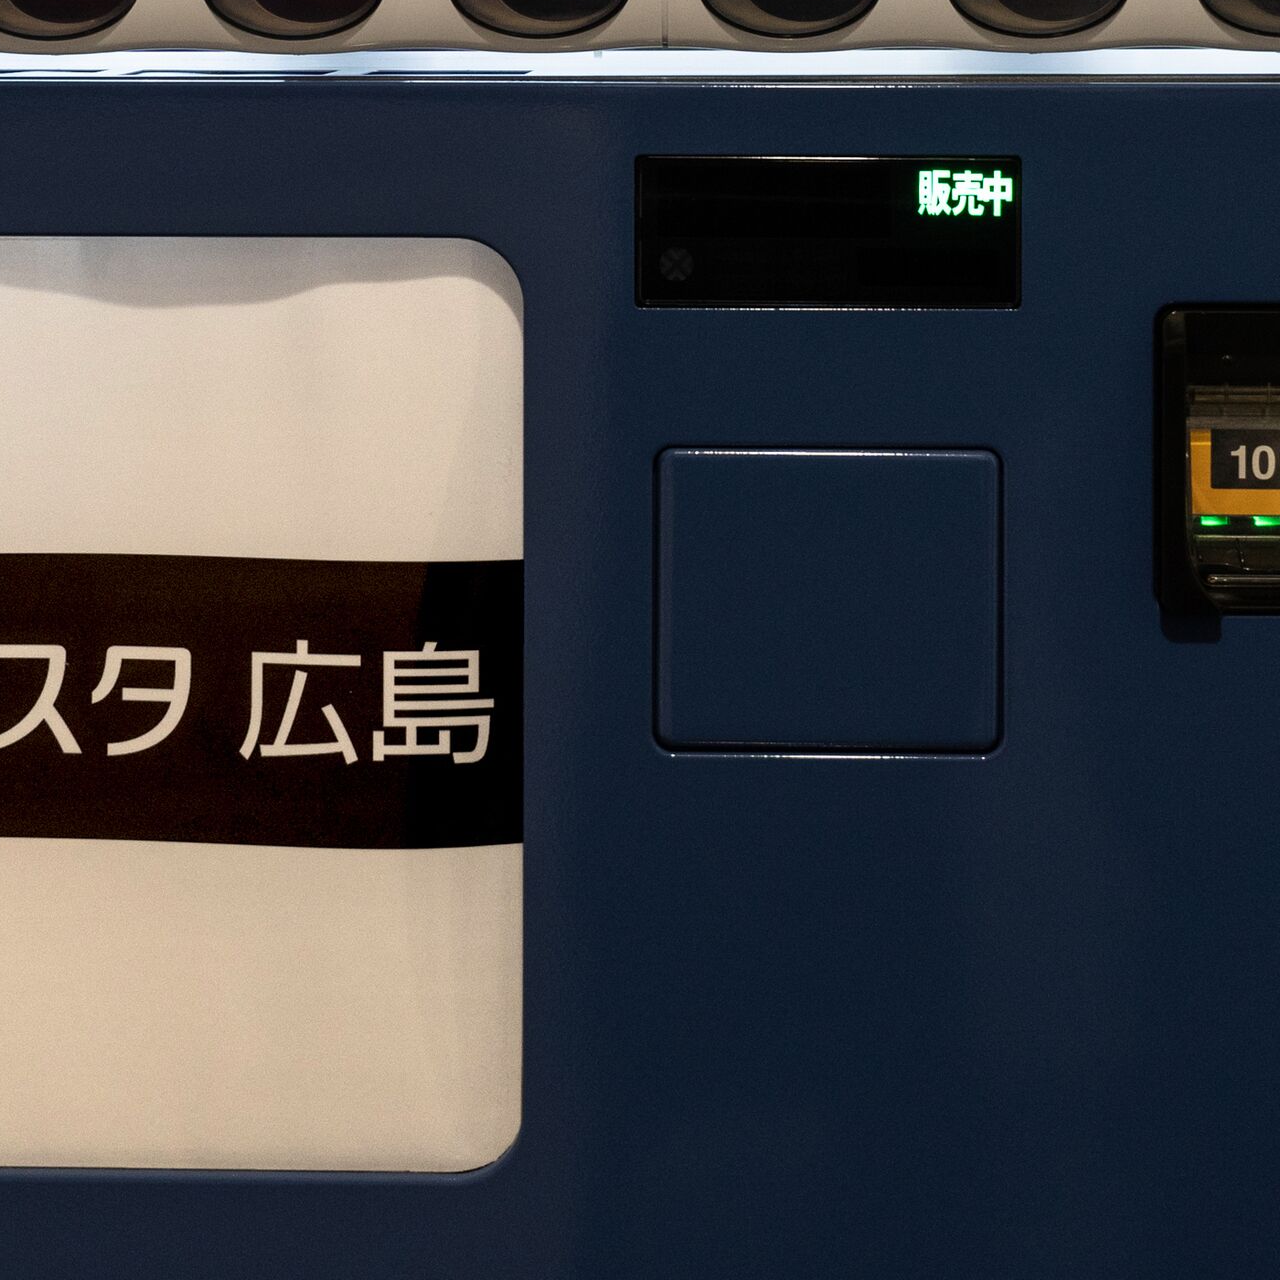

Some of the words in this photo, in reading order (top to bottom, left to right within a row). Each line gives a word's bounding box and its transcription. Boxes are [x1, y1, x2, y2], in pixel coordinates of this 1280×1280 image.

[917, 170, 1013, 216] 販売中
[237, 638, 495, 767] 広島
